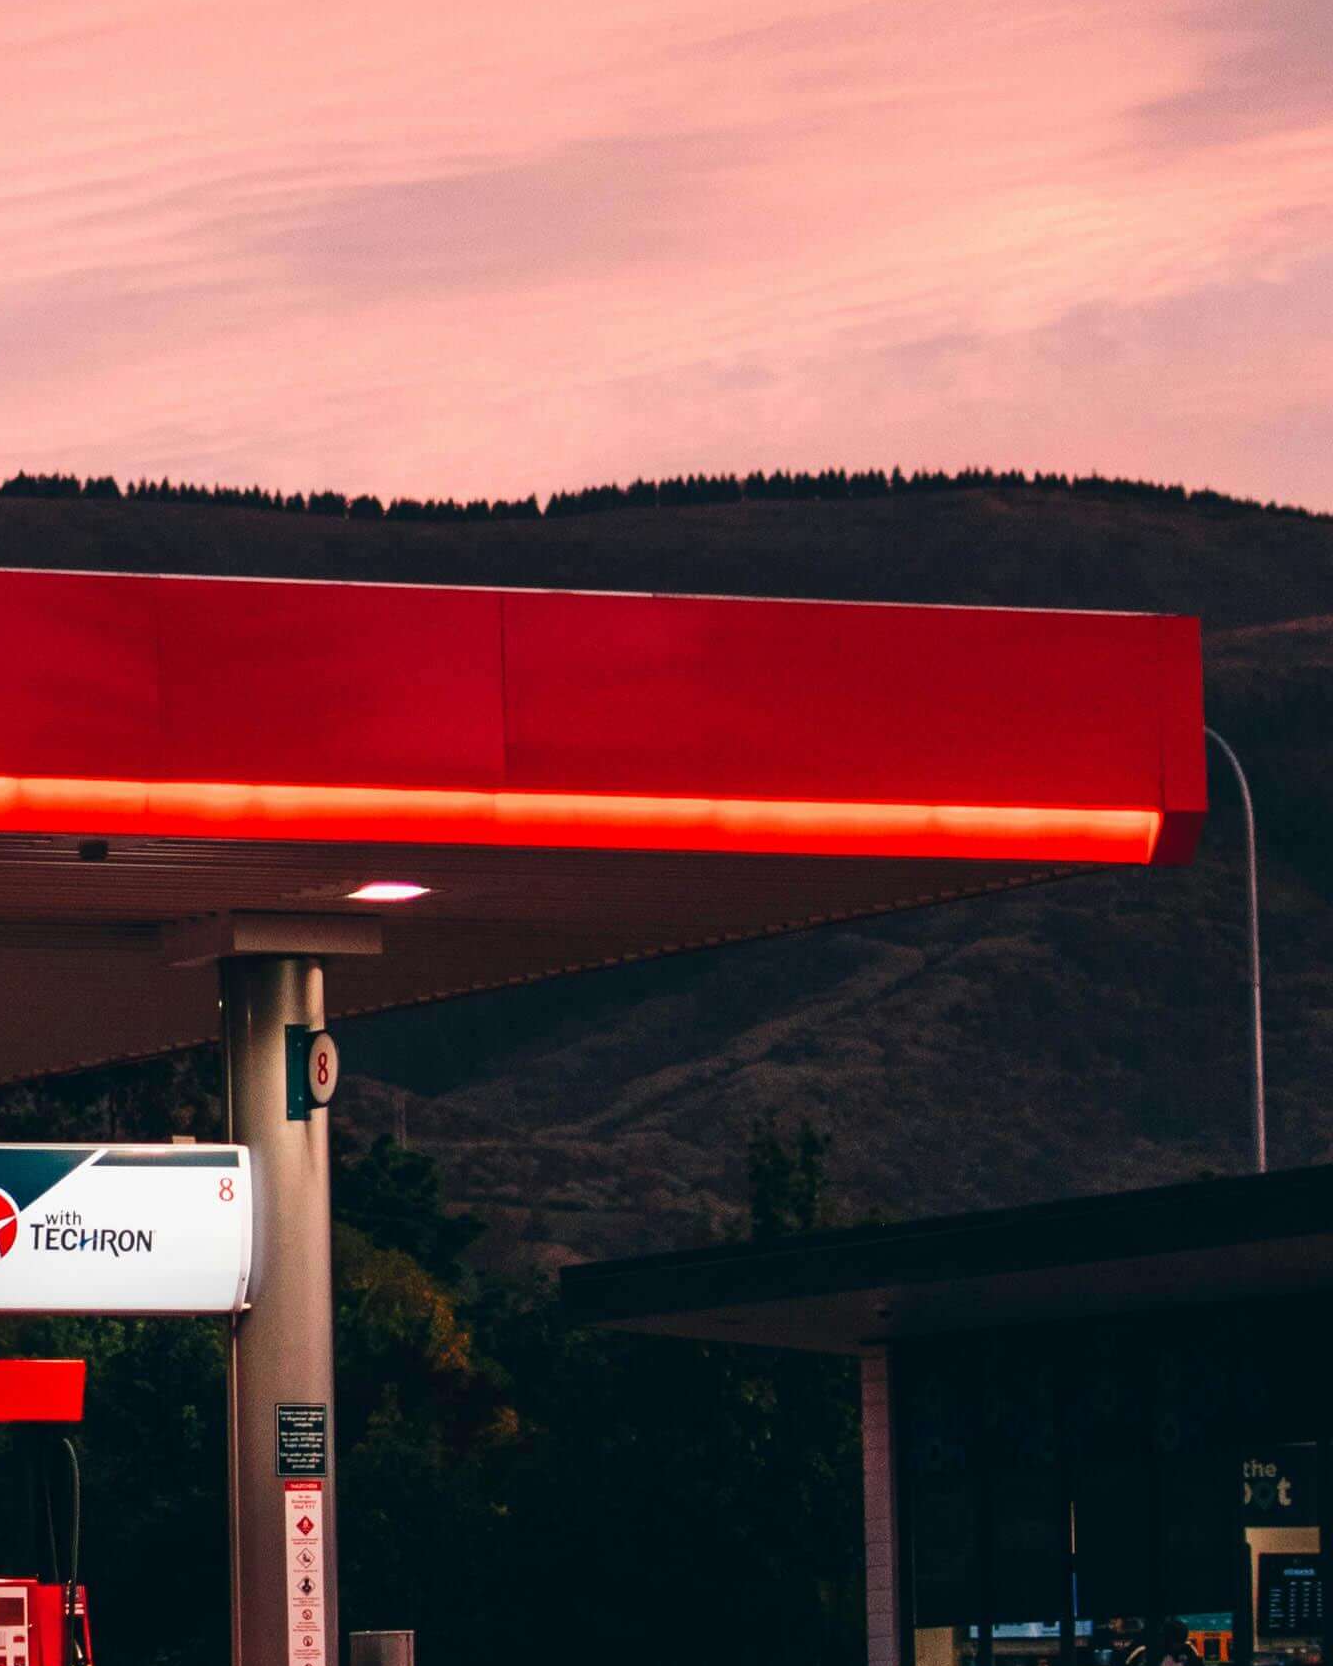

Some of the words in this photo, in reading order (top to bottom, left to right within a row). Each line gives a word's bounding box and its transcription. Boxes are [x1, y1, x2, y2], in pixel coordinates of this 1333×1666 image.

[317, 1052, 329, 1085] 8
[218, 1176, 235, 1203] 8
[44, 1209, 82, 1226] with
[29, 1223, 154, 1258] TECHRON
